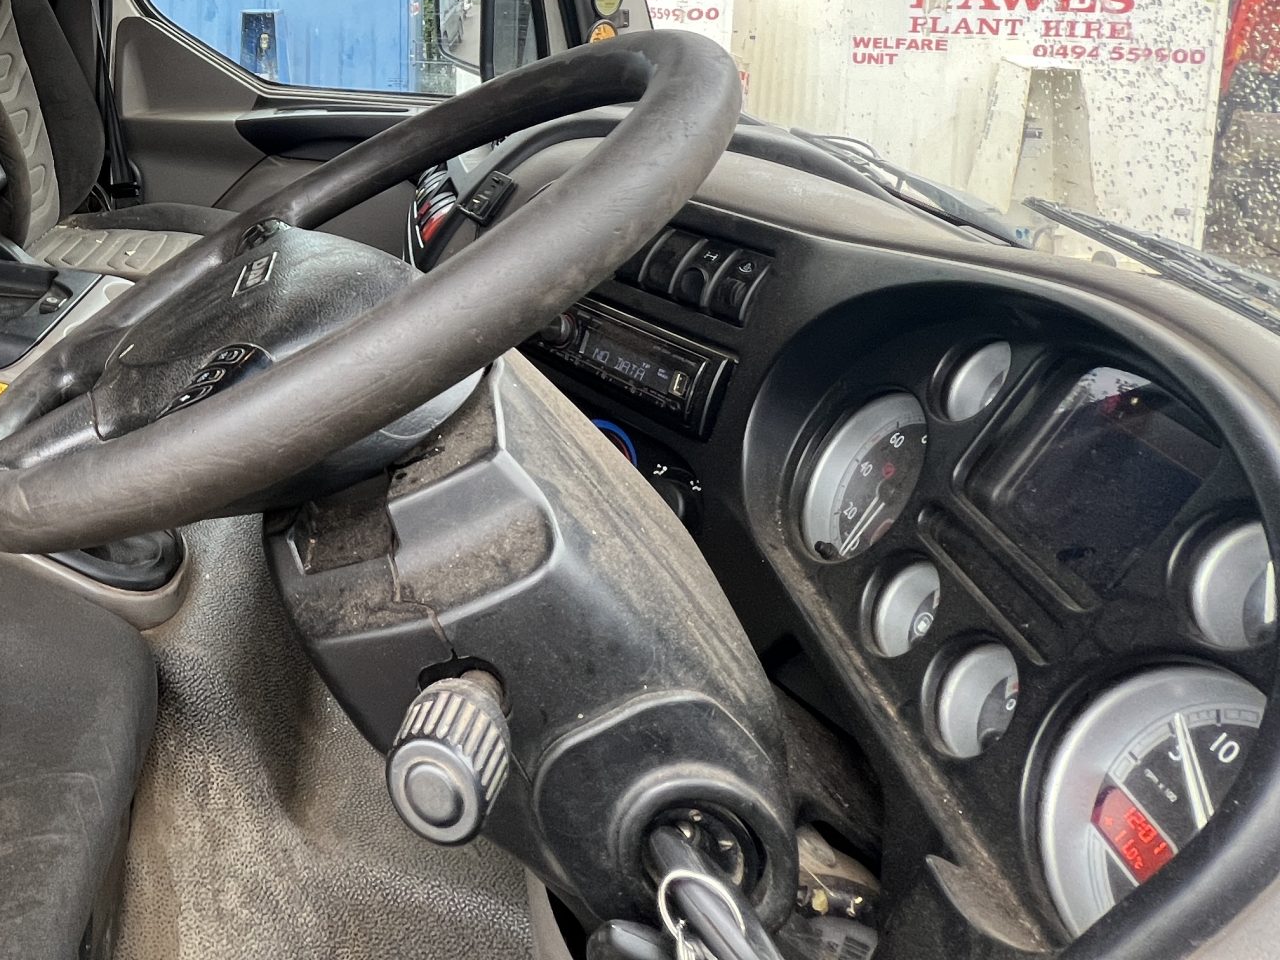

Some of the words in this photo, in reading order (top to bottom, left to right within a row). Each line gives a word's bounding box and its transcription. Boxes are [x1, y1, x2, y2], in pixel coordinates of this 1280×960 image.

[908, 16, 1024, 37] PLANT
[1040, 19, 1134, 40] HIRE
[852, 36, 949, 52] WELFARE
[1032, 44, 1100, 60] 01494
[852, 52, 899, 66] UNIT
[614, 357, 646, 381] DATA
[890, 432, 905, 449] 60
[860, 461, 873, 477] 40
[843, 502, 858, 520] 20
[1209, 732, 1241, 764] 10
